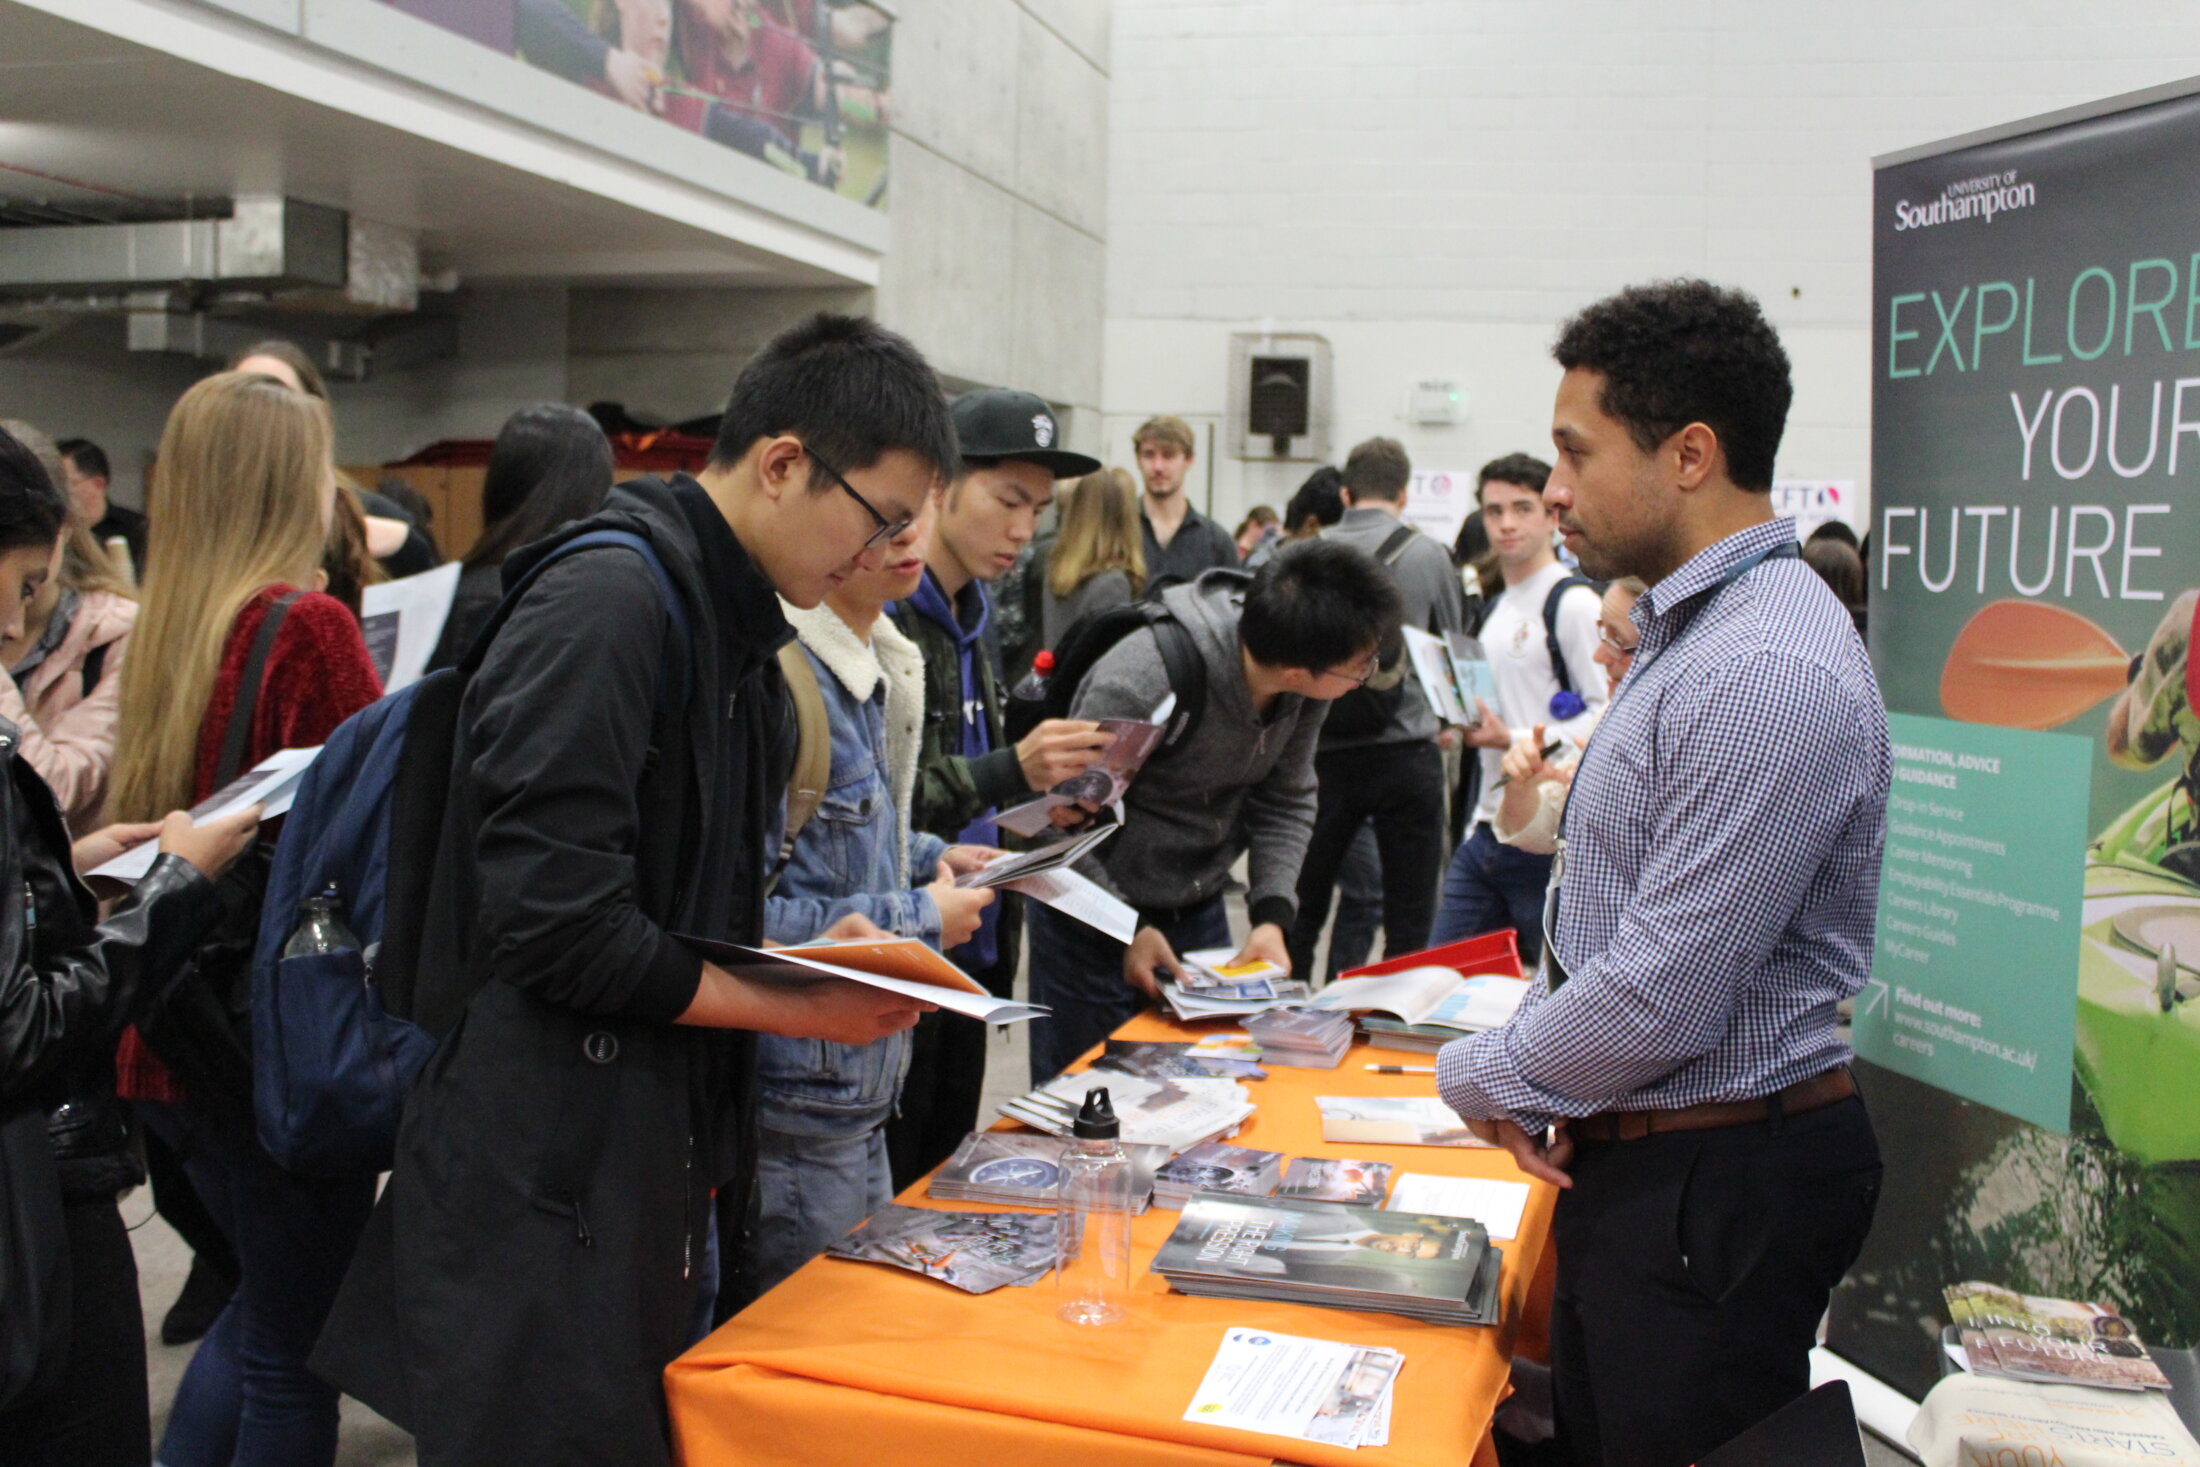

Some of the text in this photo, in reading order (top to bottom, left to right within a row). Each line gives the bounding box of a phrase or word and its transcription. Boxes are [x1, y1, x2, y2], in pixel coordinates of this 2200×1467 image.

[1947, 169, 2018, 198] UNIVERSITY OF
[1895, 182, 2036, 231] Southampton
[1882, 504, 2171, 600] FUTURE
[1893, 744, 2001, 774] ORMATION, ADVICE
[1900, 767, 1957, 789] GUIDANCE
[1928, 802, 1964, 822] Service
[1890, 819, 2005, 856] Guidance Appointments
[1921, 851, 1973, 879] Mentoring
[1888, 867, 1949, 898] Employability
[2000, 893, 2060, 922] Programme
[1895, 986, 1921, 1009] Find
[1922, 997, 1944, 1015] out
[1892, 1033, 1935, 1057] careers
[1894, 1011, 2038, 1073] www.southampton.ac.uk/
[1195, 1219, 1246, 1263] PRESSION
[1223, 1219, 1274, 1267] THE RIGHT
[1986, 1313, 2052, 1337] INTO
[1998, 1335, 2117, 1365] FUTURE
